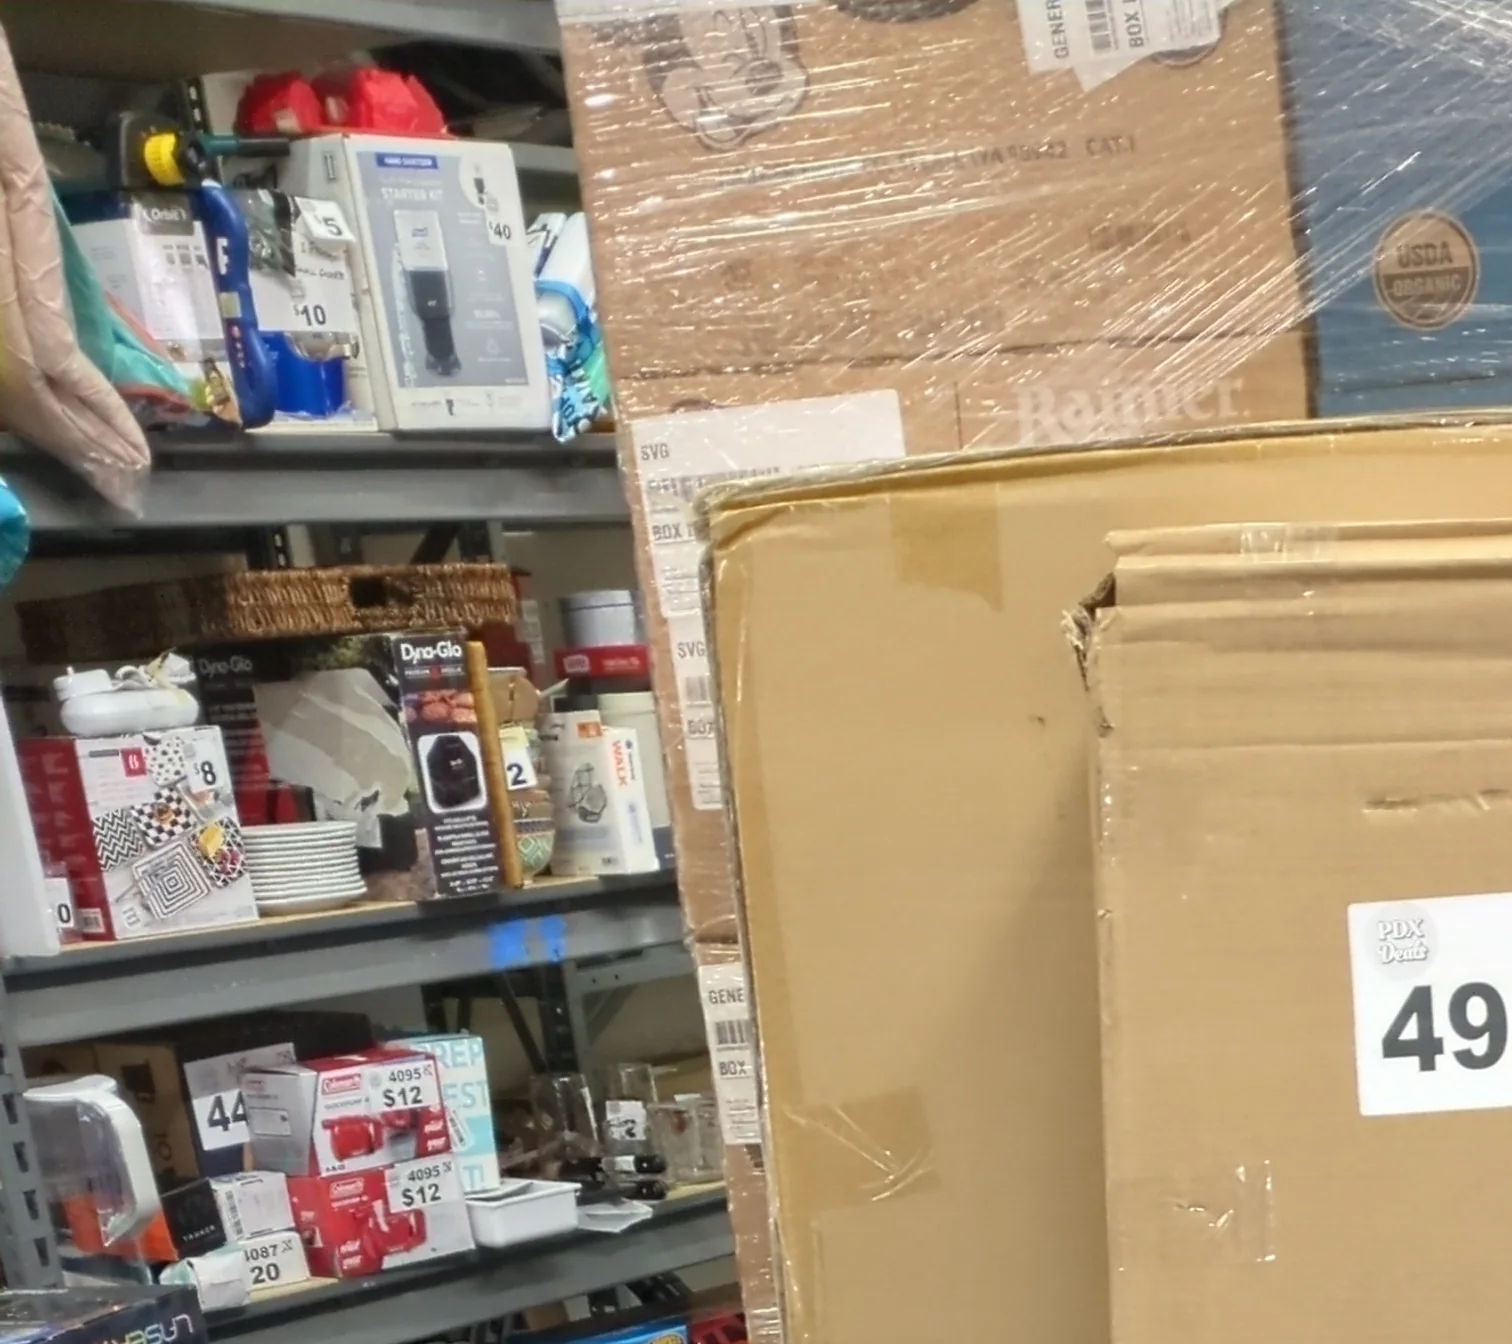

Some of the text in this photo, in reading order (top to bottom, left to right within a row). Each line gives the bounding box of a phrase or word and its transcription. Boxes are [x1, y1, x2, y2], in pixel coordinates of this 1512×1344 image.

[1124, 12, 1145, 48] BOX
[1396, 242, 1453, 268] USDA
[1391, 274, 1462, 299] ORGANIC
[641, 443, 670, 462] SVG
[652, 522, 682, 542] BOX
[400, 640, 463, 665] Dyno-Glo
[677, 641, 706, 659] SVG
[1377, 918, 1425, 942] PDX
[1379, 941, 1430, 965] Deals
[388, 1066, 422, 1083] 4095
[718, 1059, 748, 1077] BOX
[382, 1086, 423, 1108] $12
[408, 1164, 441, 1183] 4095
[402, 1183, 442, 1207] $12
